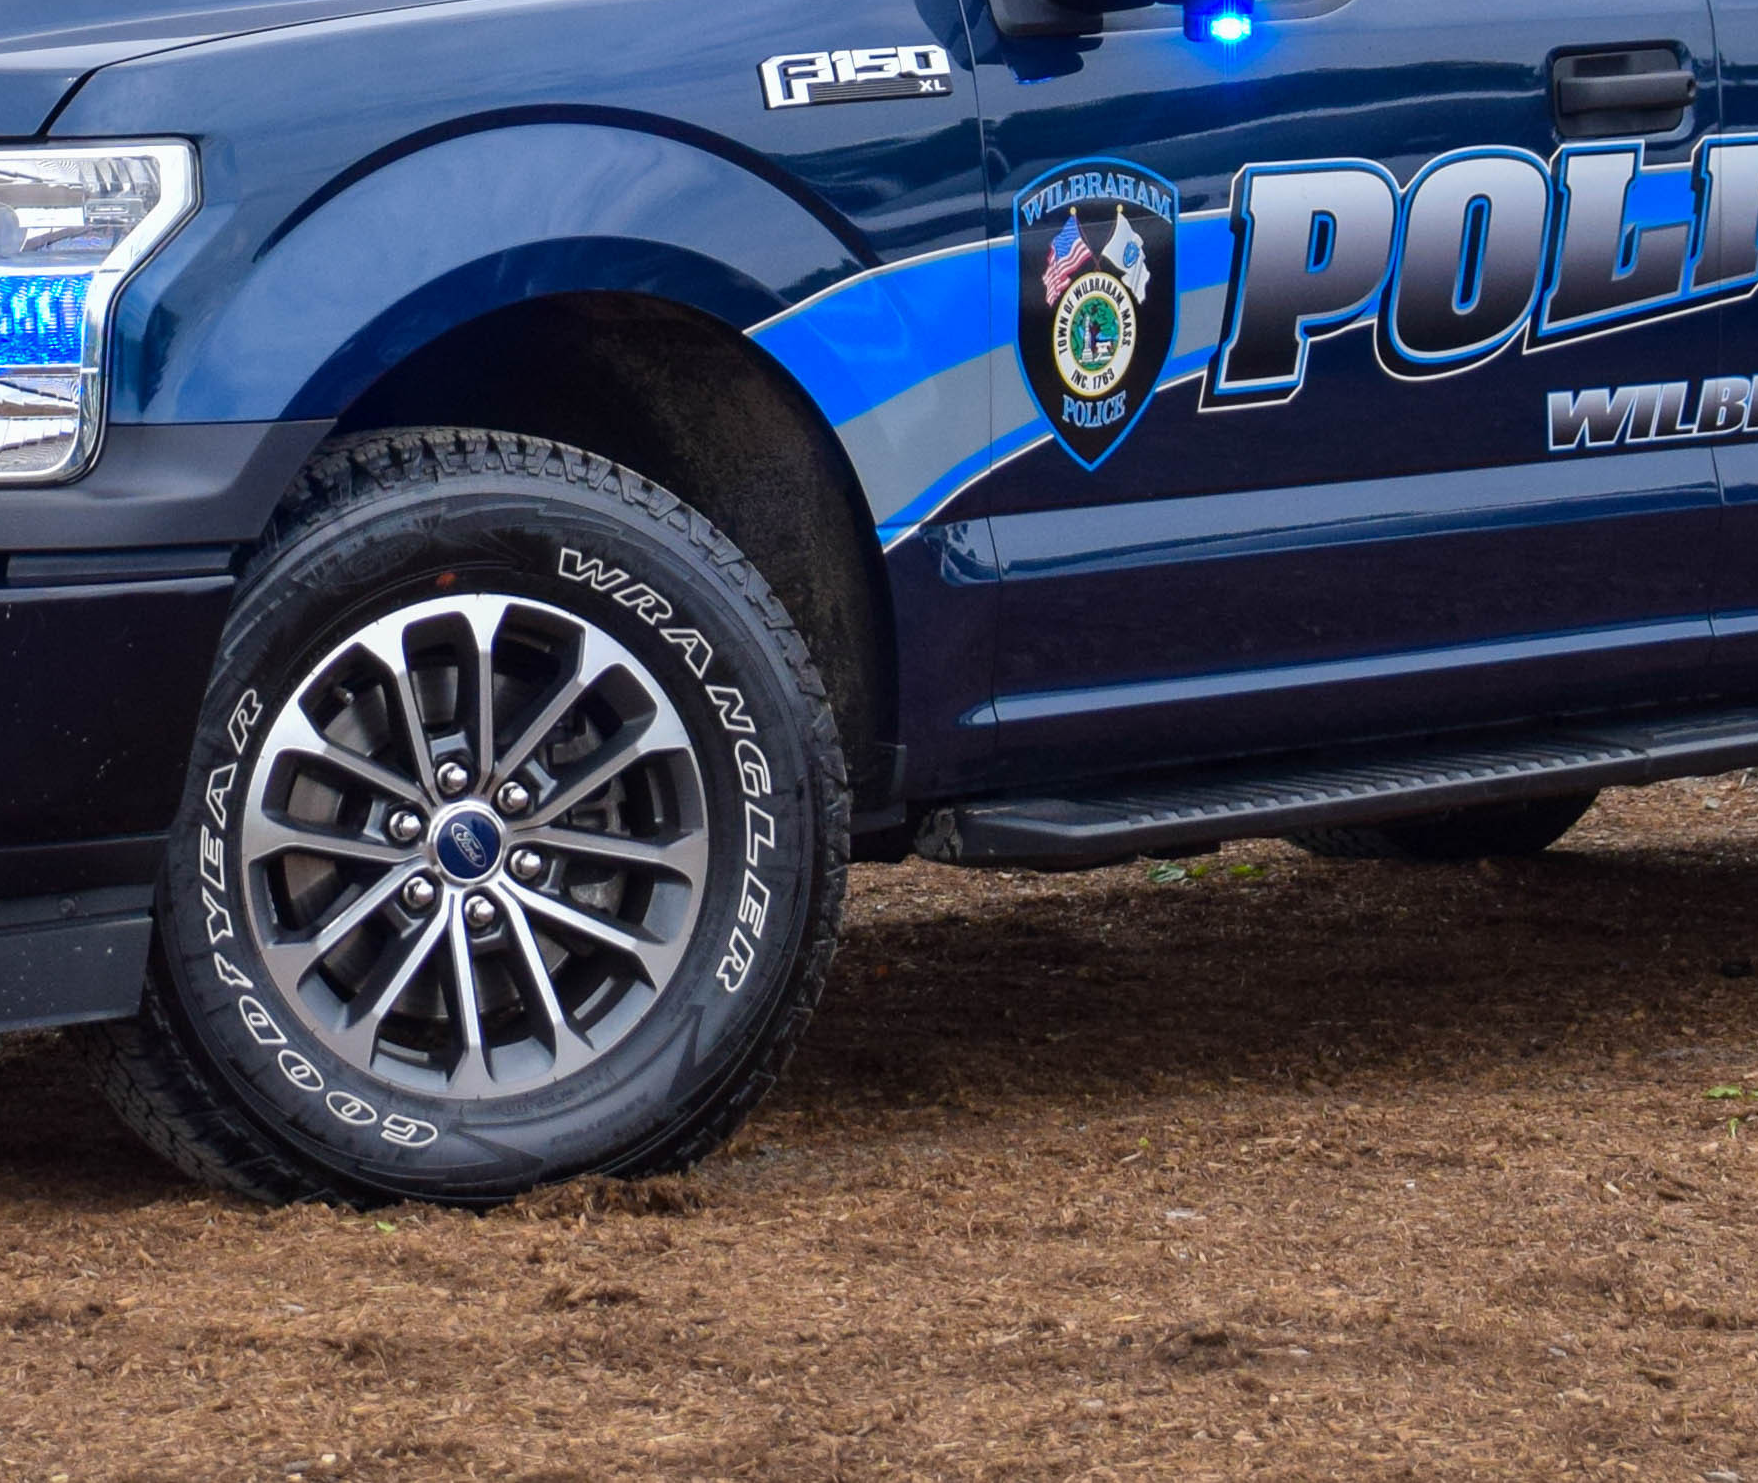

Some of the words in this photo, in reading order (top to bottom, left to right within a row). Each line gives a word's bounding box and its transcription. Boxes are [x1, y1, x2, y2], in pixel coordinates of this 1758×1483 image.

[919, 79, 948, 92] XL
[1021, 172, 1173, 226] WILBRAHAM
[1057, 316, 1069, 355] TOWN
[1063, 295, 1076, 316] OF
[1062, 389, 1127, 428] POLICE
[558, 547, 776, 994] WRANGLER
[200, 688, 440, 1149] GOODYEAR
